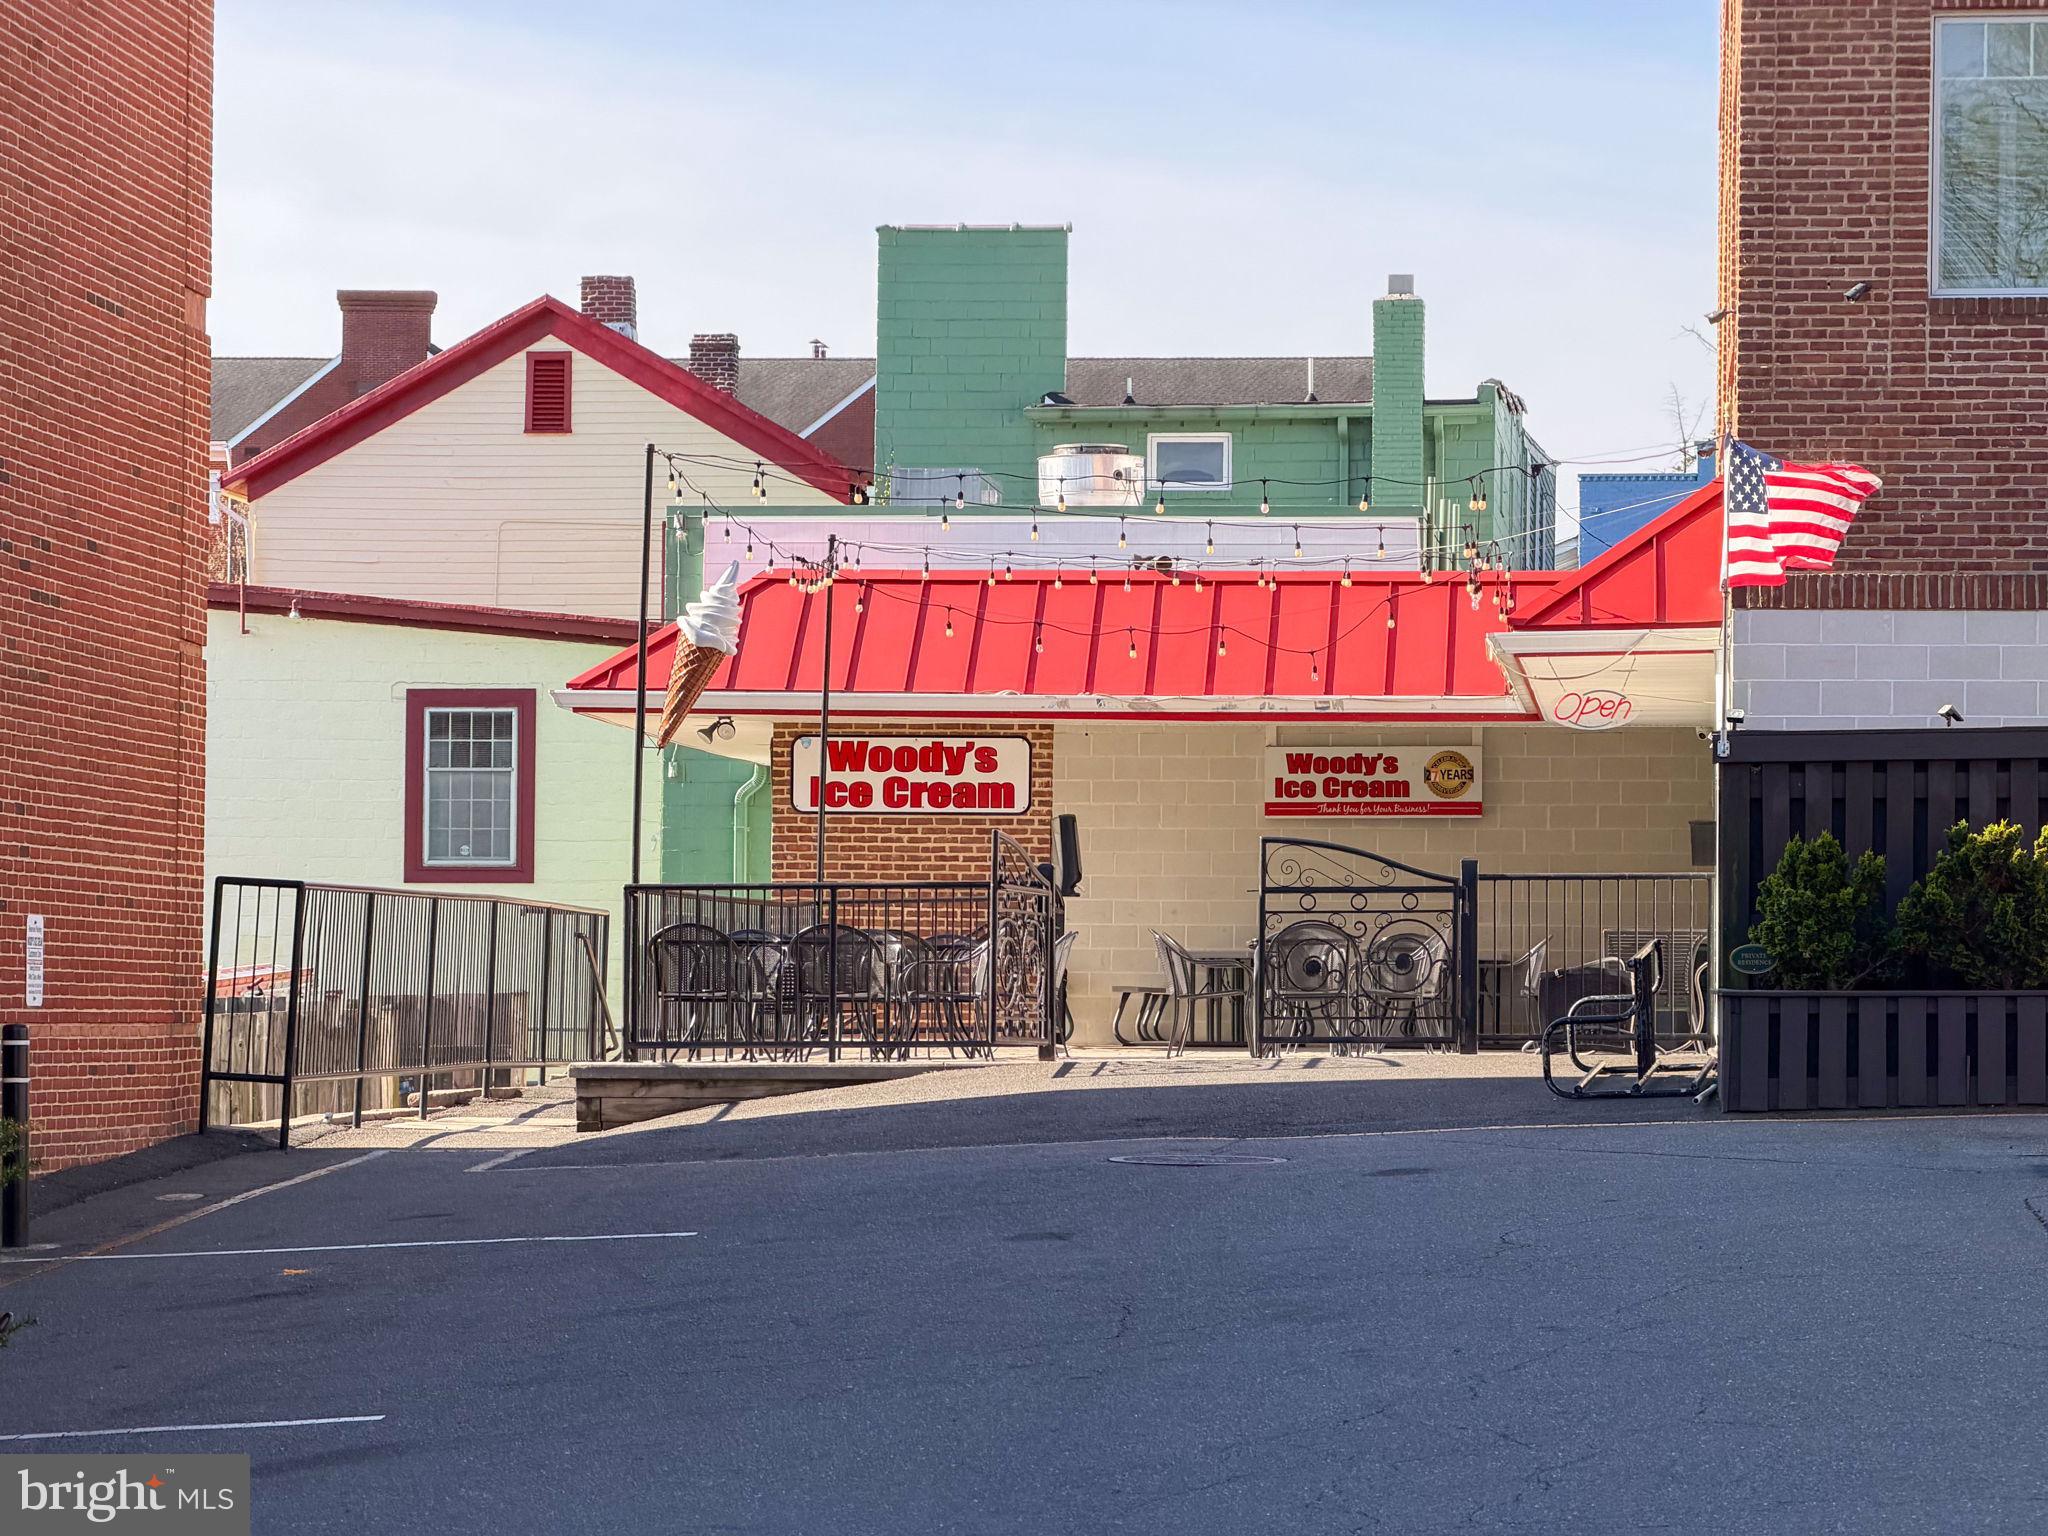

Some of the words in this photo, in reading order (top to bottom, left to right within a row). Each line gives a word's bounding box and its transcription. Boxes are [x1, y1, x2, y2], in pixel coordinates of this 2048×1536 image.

[1554, 692, 1632, 724] Open
[826, 740, 998, 776] Woody's
[1286, 752, 1399, 776] Woody's
[1440, 769, 1473, 780] YEARS
[810, 776, 873, 808] Ice
[882, 776, 1015, 808] Cream
[1274, 777, 1317, 798] Ice
[1322, 776, 1410, 798] Cream
[1317, 803, 1341, 813] Thank
[1343, 804, 1359, 815] You
[1360, 803, 1372, 815] for
[1373, 804, 1393, 815] Your
[1394, 803, 1430, 813] Business!
